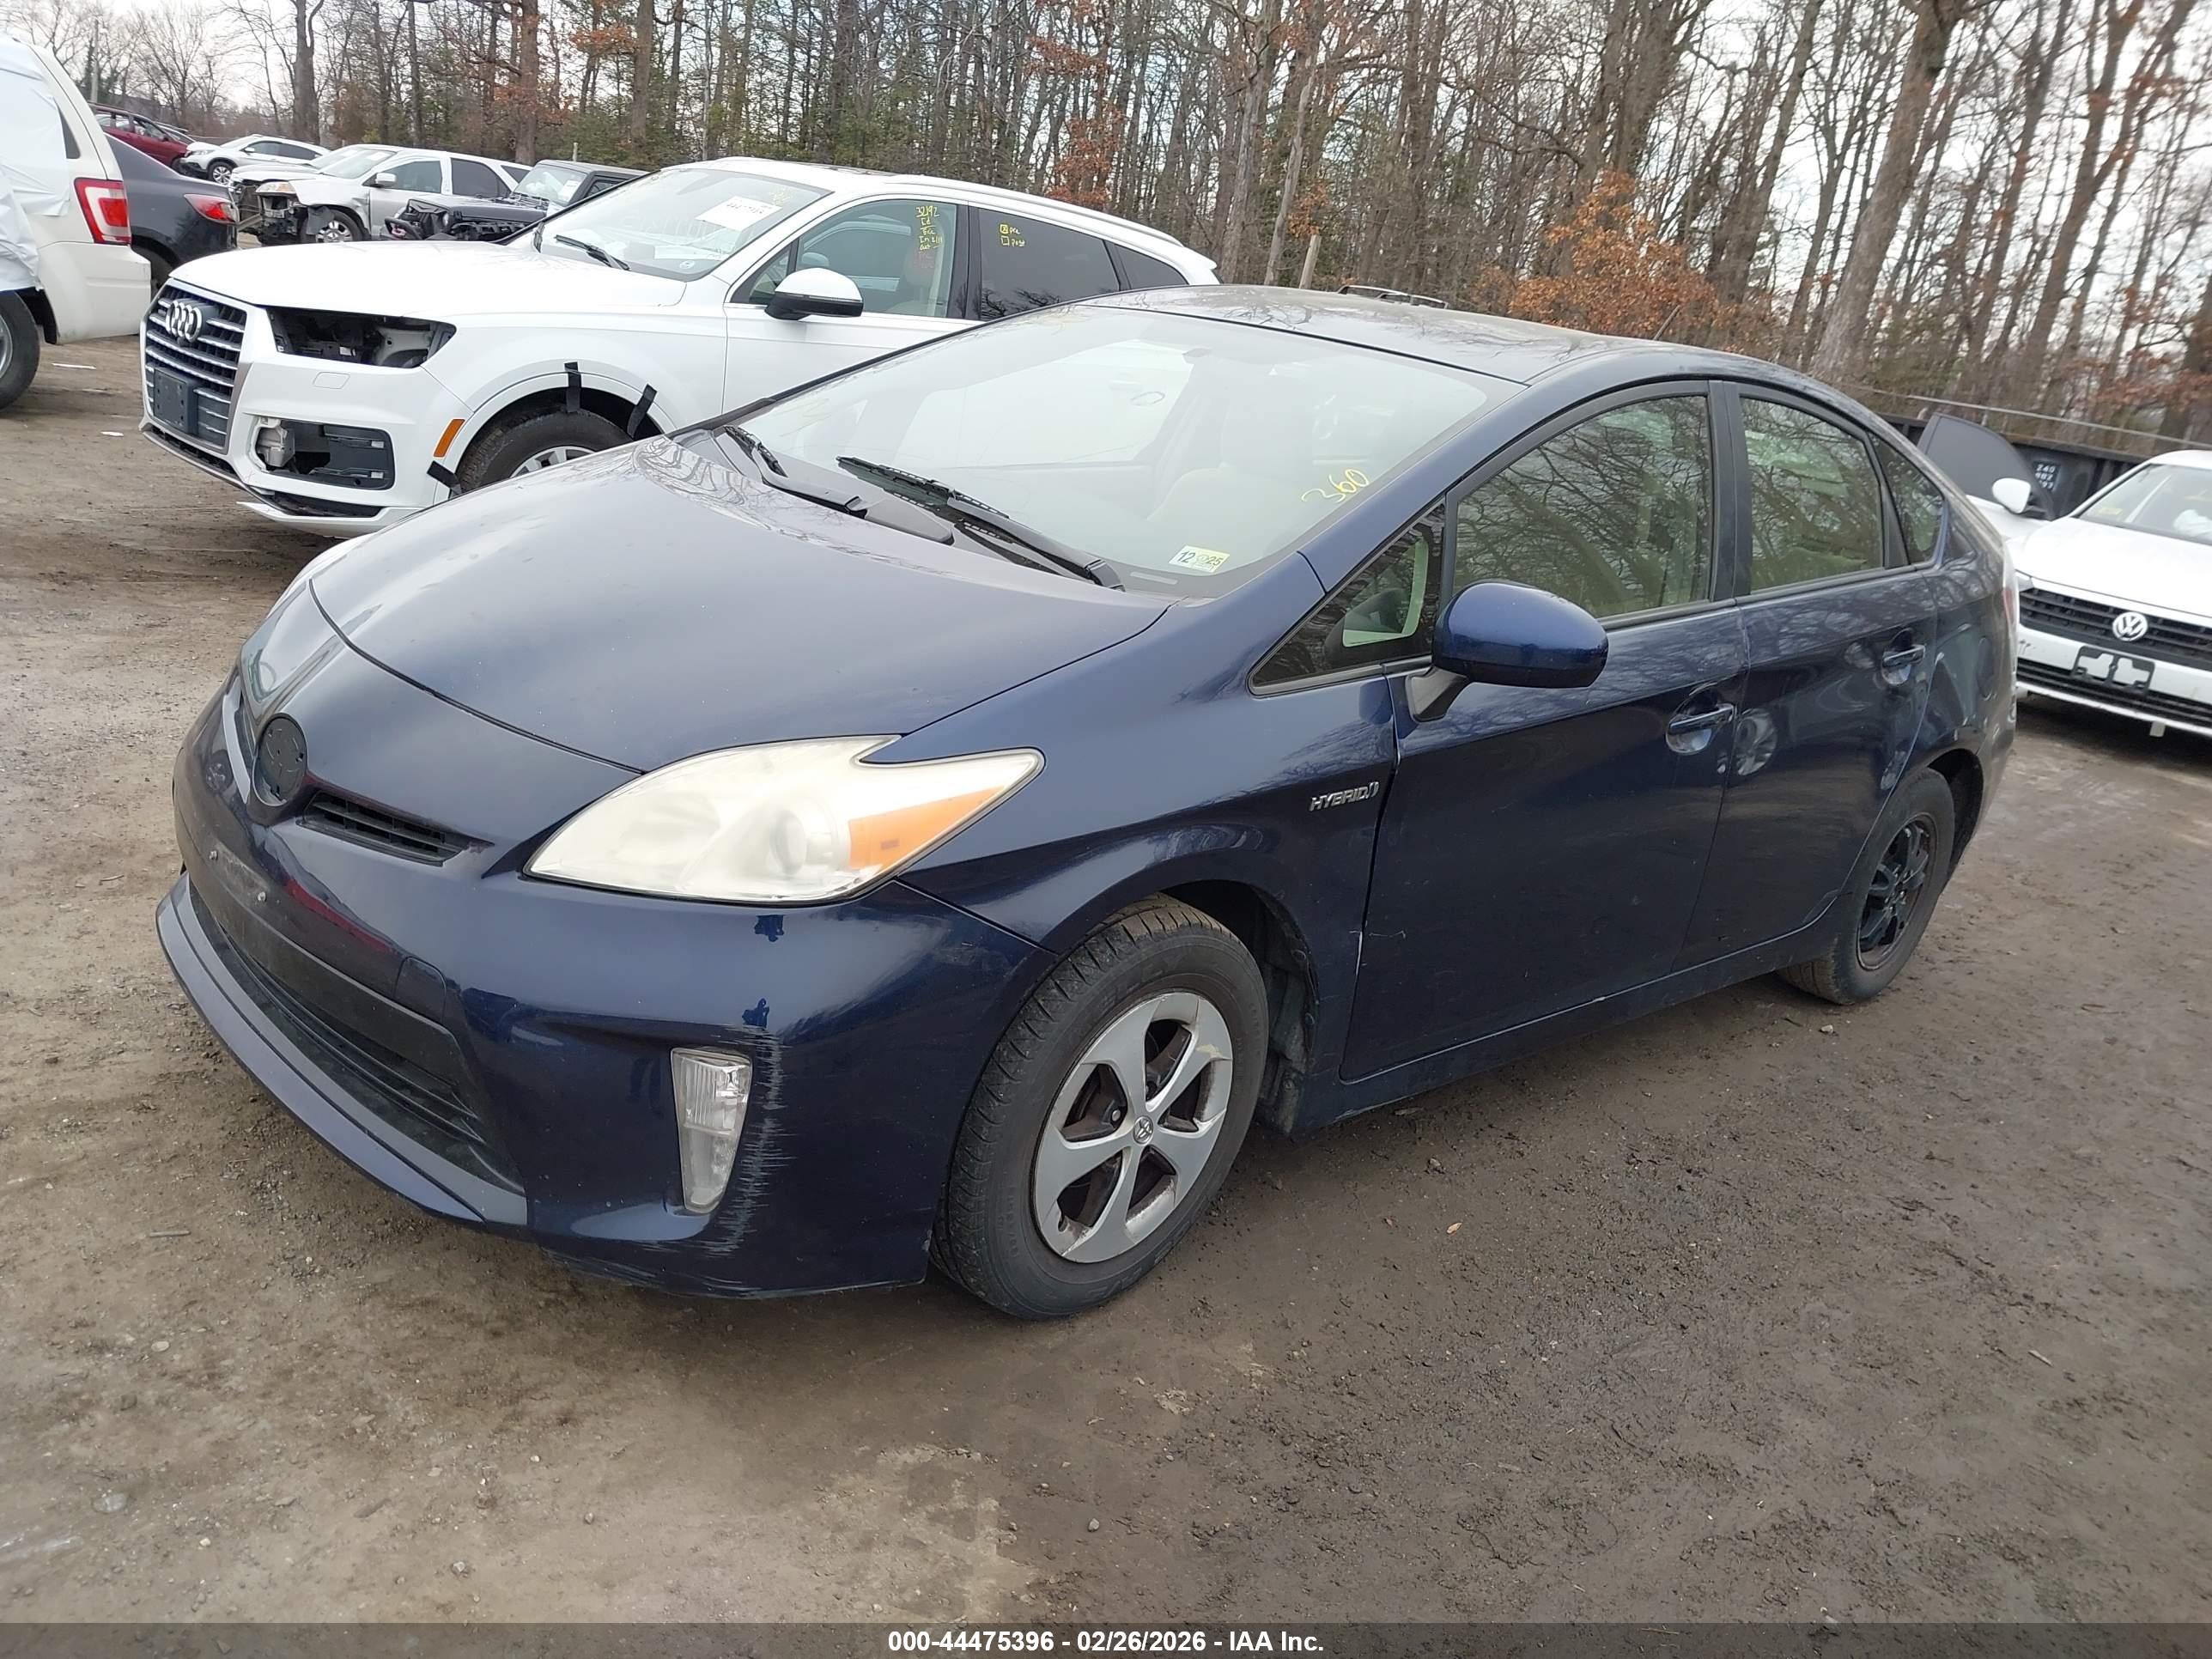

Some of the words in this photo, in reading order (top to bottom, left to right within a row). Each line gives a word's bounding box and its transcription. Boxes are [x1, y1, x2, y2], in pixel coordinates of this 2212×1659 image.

[1301, 469, 1370, 503] 360
[1177, 550, 1195, 562] 12
[1206, 556, 1223, 566] 25
